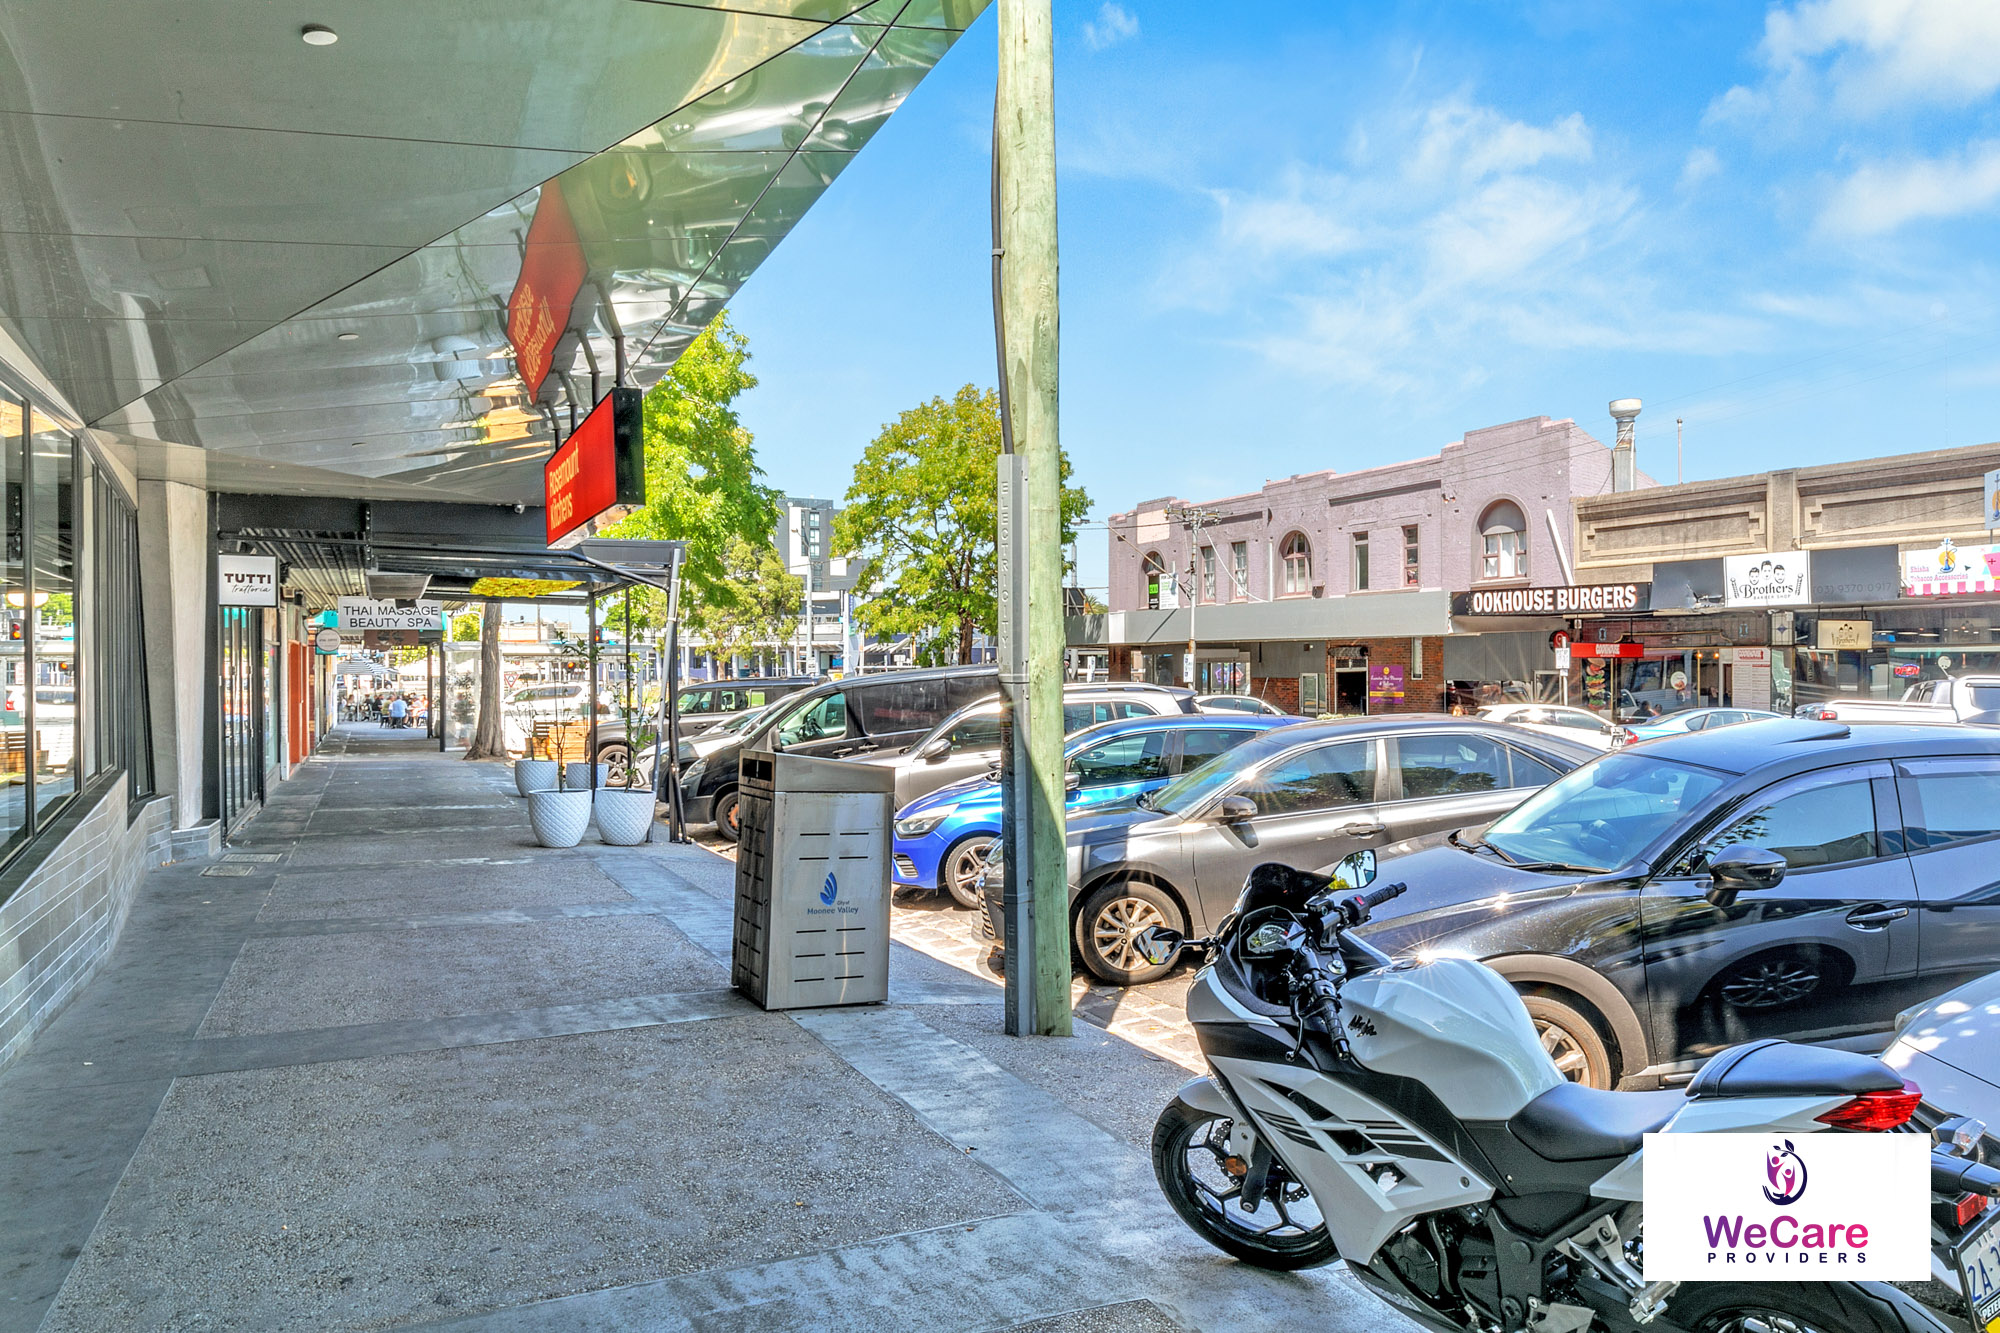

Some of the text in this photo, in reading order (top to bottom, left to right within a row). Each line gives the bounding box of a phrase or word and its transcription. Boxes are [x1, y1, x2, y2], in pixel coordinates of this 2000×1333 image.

[549, 441, 579, 498] Rosemount
[550, 491, 573, 530] Kitchens
[1001, 481, 1009, 649] ELECTRICITY
[1910, 565, 1930, 573] Shisha
[224, 573, 271, 584] TUTTI
[1910, 573, 1968, 582] Tobacco Accessories
[232, 584, 272, 594] trattoria
[1739, 582, 1793, 598] Brothers
[1838, 584, 1863, 594] 9370
[1867, 582, 1891, 592] 0917
[1473, 585, 1637, 613] OOKHOUSE BURGERS
[343, 606, 439, 616] THAI MASSAGE
[350, 618, 432, 628] BEAUTY SPA
[1835, 636, 1856, 646] Brothers
[1894, 665, 1920, 676] OPEN
[837, 906, 858, 914] Valley
[1976, 1229, 1994, 1248] VIC
